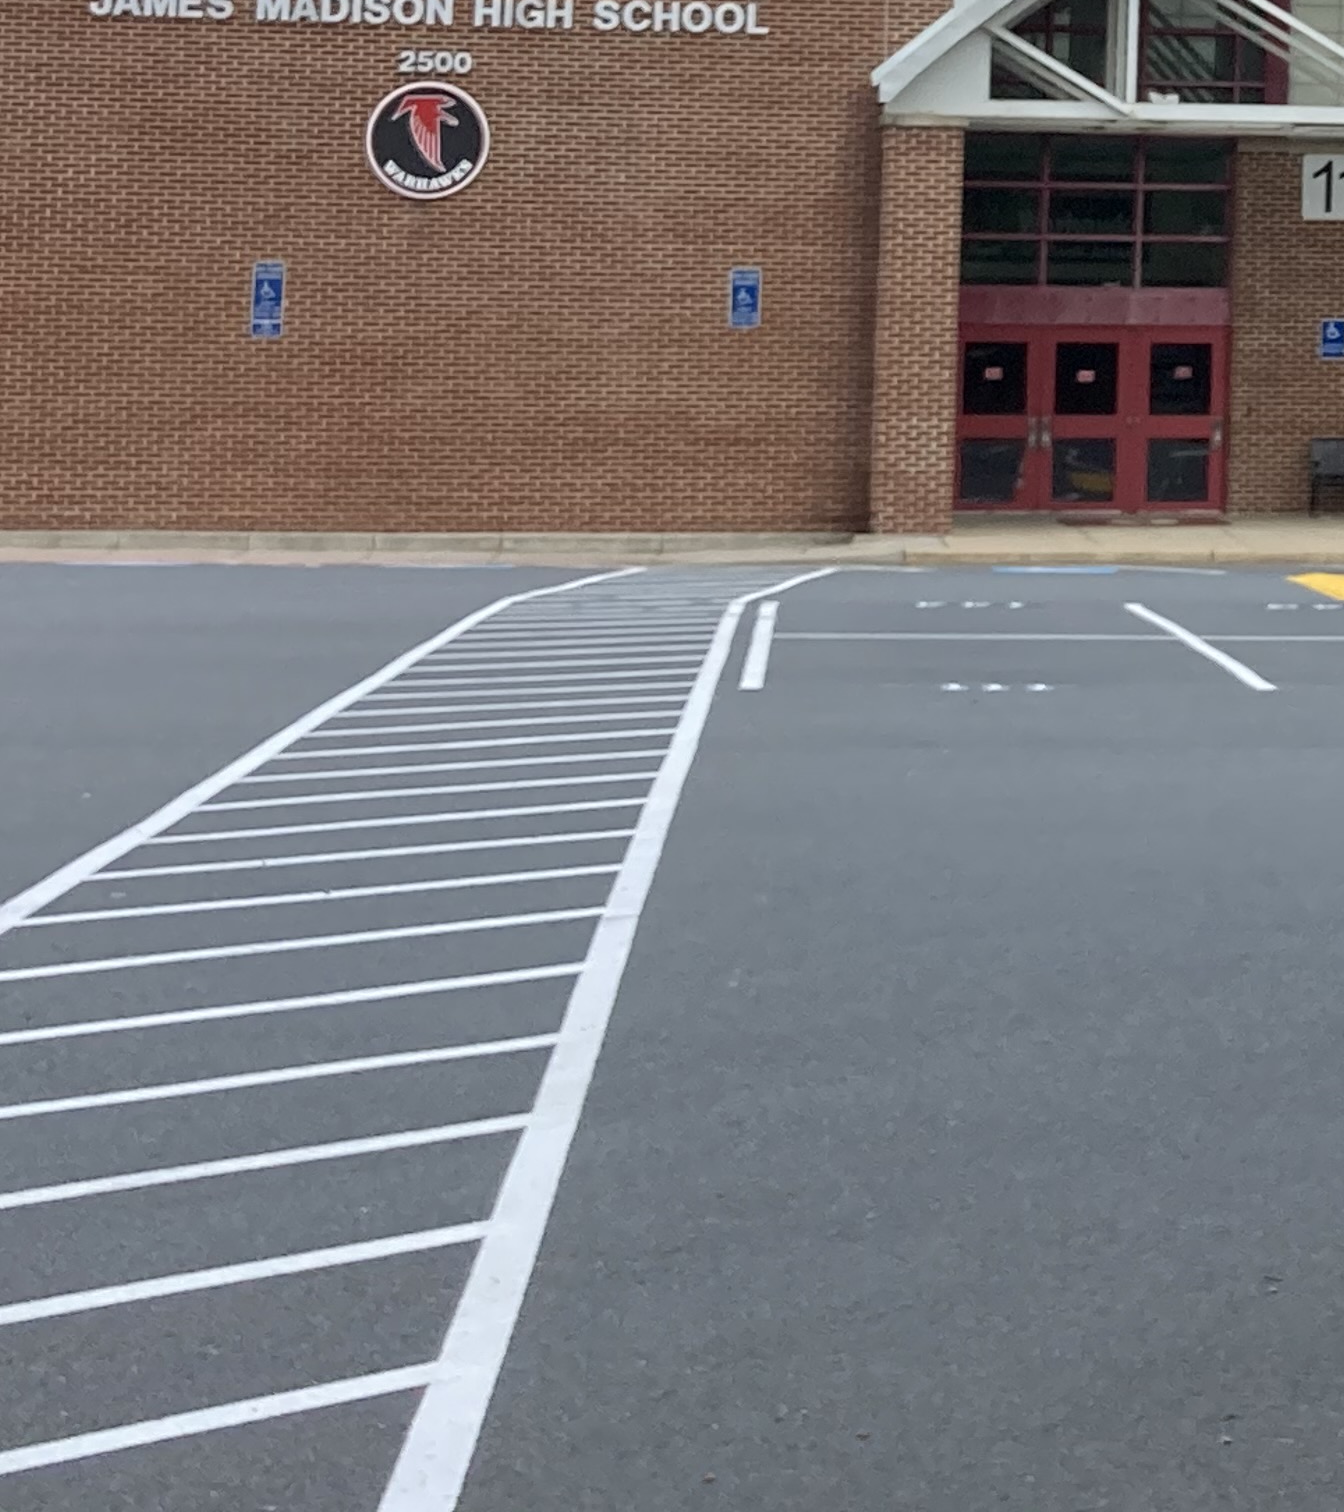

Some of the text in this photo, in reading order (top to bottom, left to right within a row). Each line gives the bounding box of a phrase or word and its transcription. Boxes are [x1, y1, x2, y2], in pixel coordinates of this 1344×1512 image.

[593, 0, 769, 34] SCHOOL
[399, 50, 472, 74] 2500
[383, 159, 473, 191] WARHAWKS
